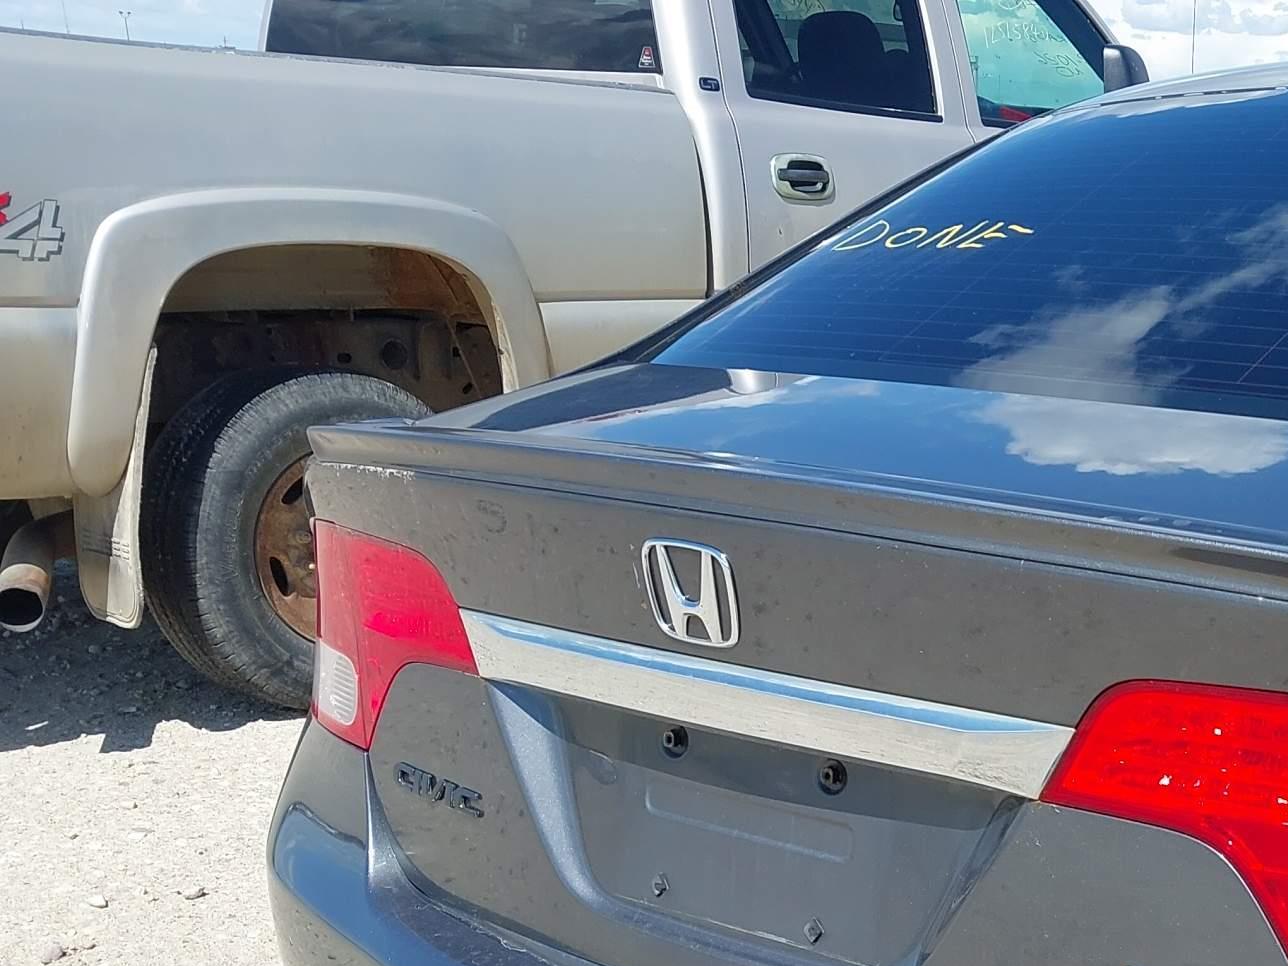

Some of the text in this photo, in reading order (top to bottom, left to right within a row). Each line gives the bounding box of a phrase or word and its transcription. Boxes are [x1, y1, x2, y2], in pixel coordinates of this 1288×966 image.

[700, 79, 718, 90] LT
[831, 219, 1034, 251] DONE
[395, 761, 484, 818] CIVIC
